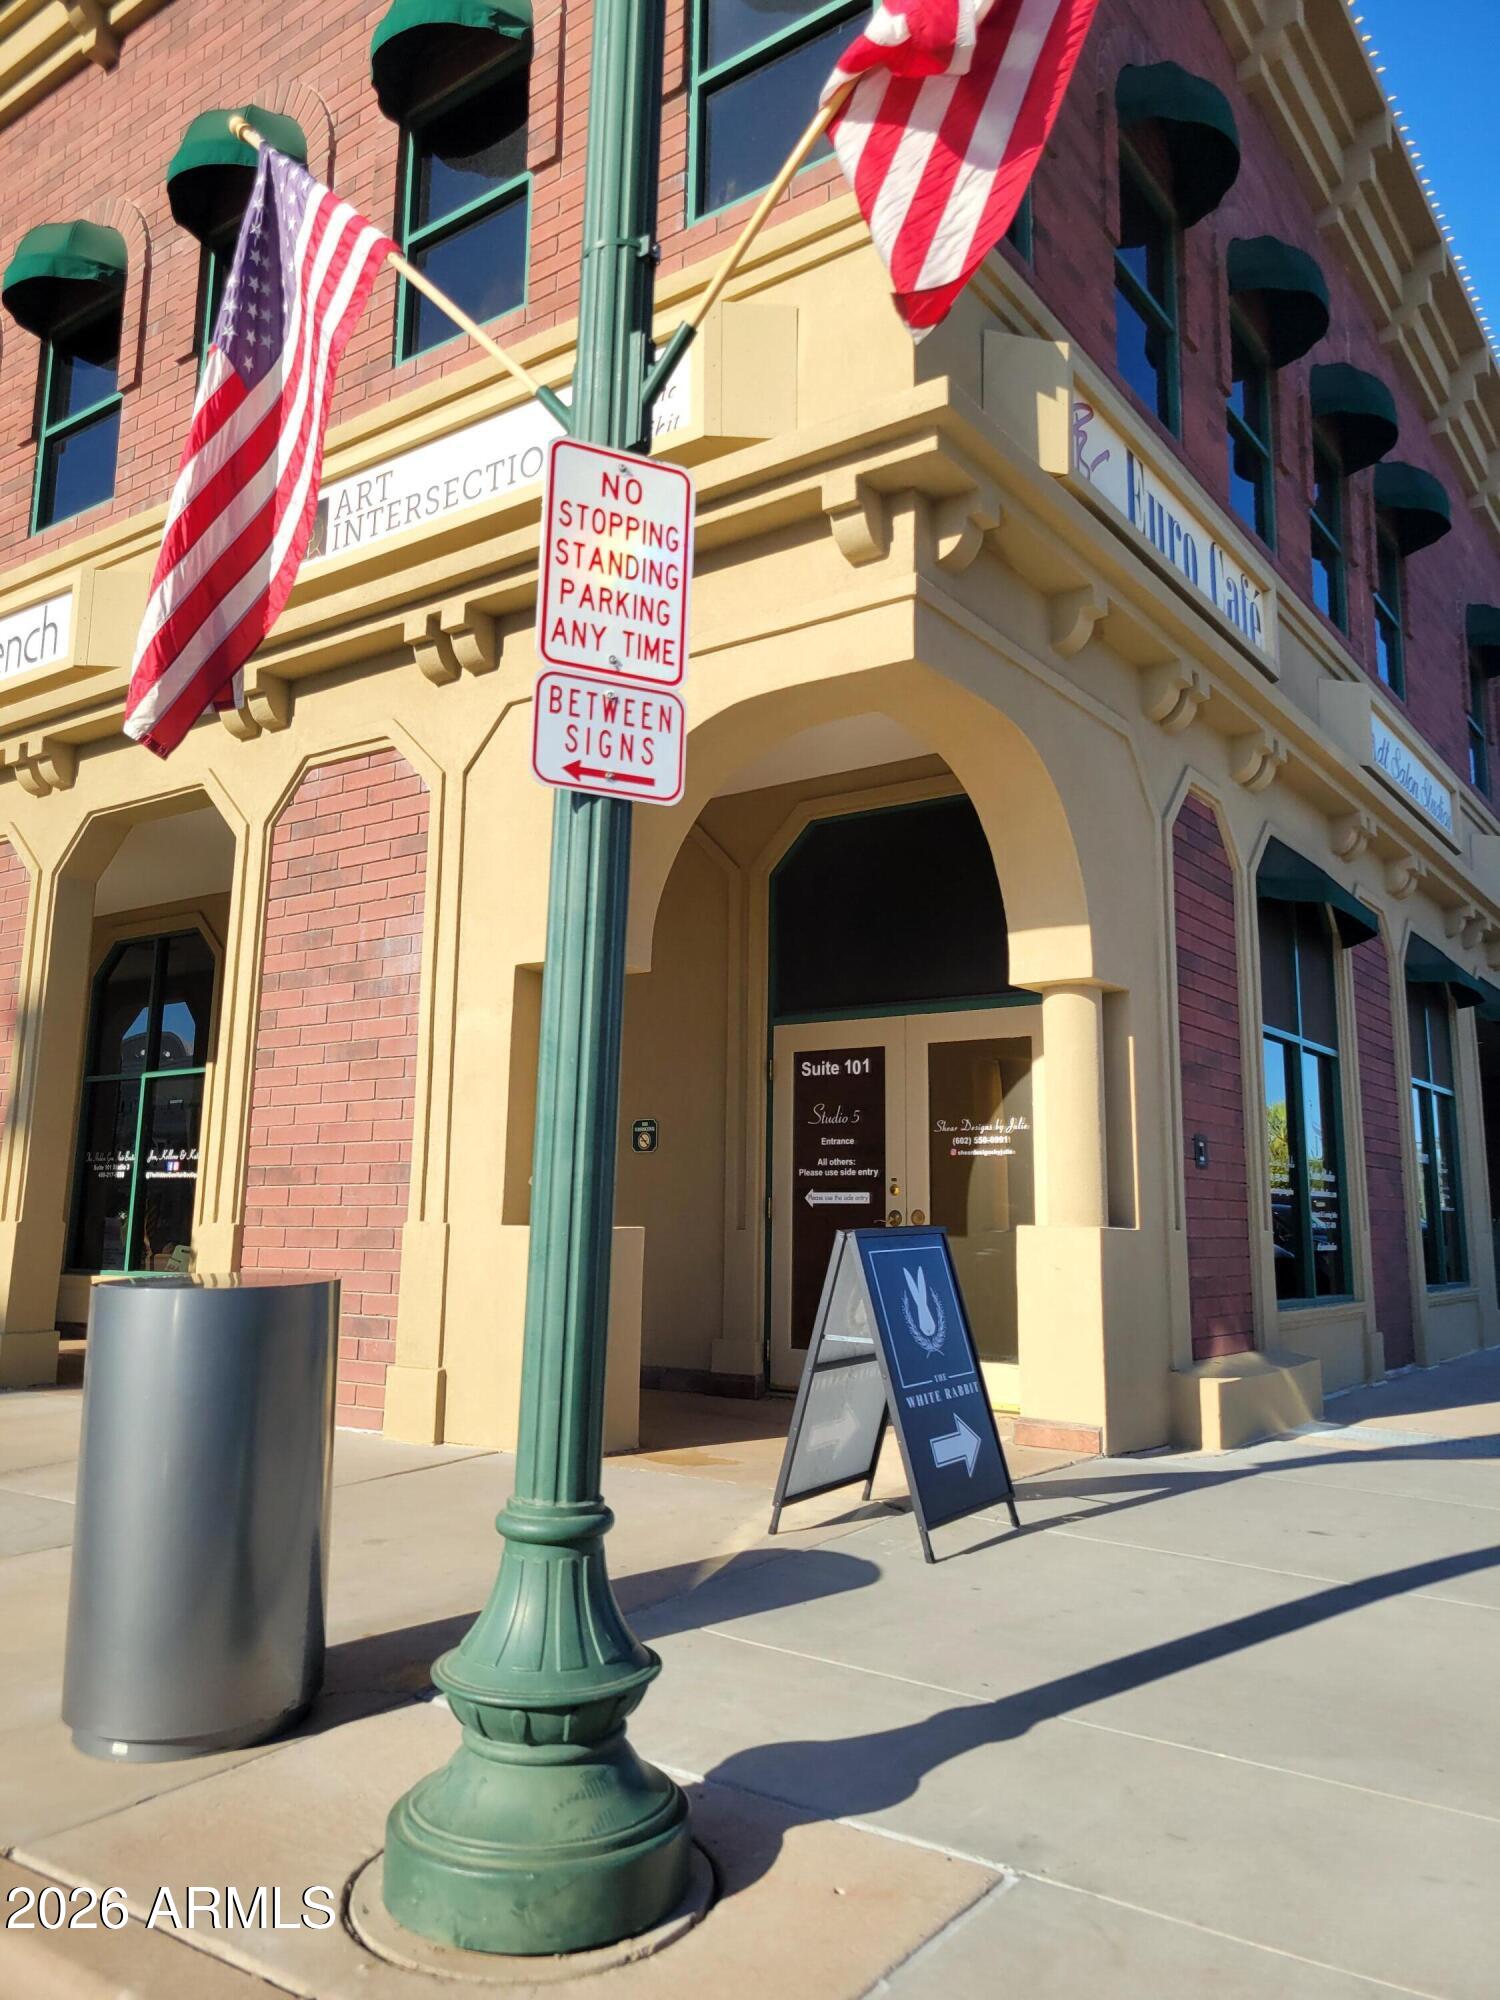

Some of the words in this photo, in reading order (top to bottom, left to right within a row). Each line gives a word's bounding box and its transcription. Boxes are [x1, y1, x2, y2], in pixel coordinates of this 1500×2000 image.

[332, 446, 544, 552] INTERSECTIO
[334, 470, 394, 521] ART
[601, 472, 643, 505] NO
[559, 500, 679, 552] STOPPING
[1127, 447, 1199, 588] Euro
[1209, 541, 1262, 645] Café
[555, 538, 679, 590] STANDING
[560, 578, 670, 627] PARKING
[551, 617, 607, 651] ANY
[622, 630, 675, 666] TIME
[549, 685, 673, 734] BETWEEN
[565, 724, 654, 766] SIGNS
[801, 1060, 840, 1077] Suite
[844, 1058, 870, 1075] 101
[807, 1103, 849, 1125] Studio
[851, 1109, 861, 1124] 5
[933, 1119, 959, 1133] Shear
[960, 1118, 993, 1134] Designs
[994, 1118, 1004, 1133] by
[1005, 1116, 1030, 1133] Julie
[820, 1137, 855, 1146] Entrance
[952, 1136, 972, 1146] (602)
[798, 1168, 823, 1177] Please
[839, 1167, 857, 1176] side
[857, 1168, 879, 1178] entry
[817, 1158, 828, 1166] All
[829, 1157, 856, 1166] others:
[905, 1390, 942, 1408] WHITE
[944, 1381, 979, 1400] RABBIT
[934, 1373, 948, 1383] THE
